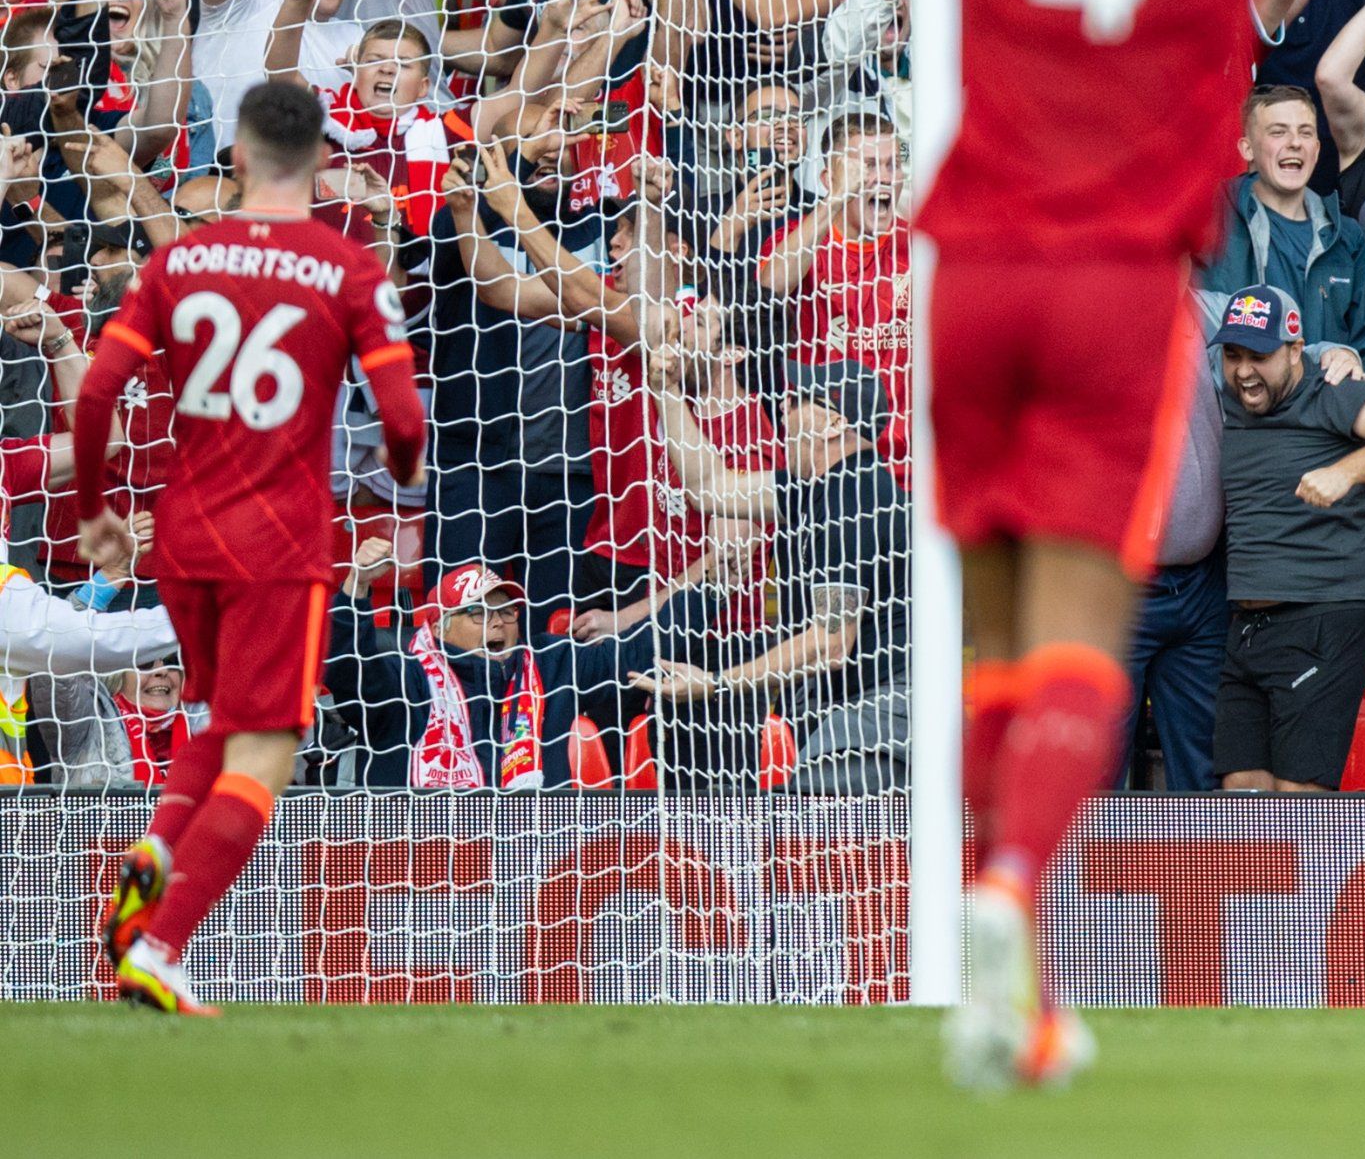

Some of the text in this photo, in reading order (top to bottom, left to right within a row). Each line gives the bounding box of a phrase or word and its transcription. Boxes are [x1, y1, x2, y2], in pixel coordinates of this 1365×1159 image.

[166, 244, 345, 296] ROBERTSON
[1245, 313, 1268, 330] Bull
[169, 291, 306, 431] 26
